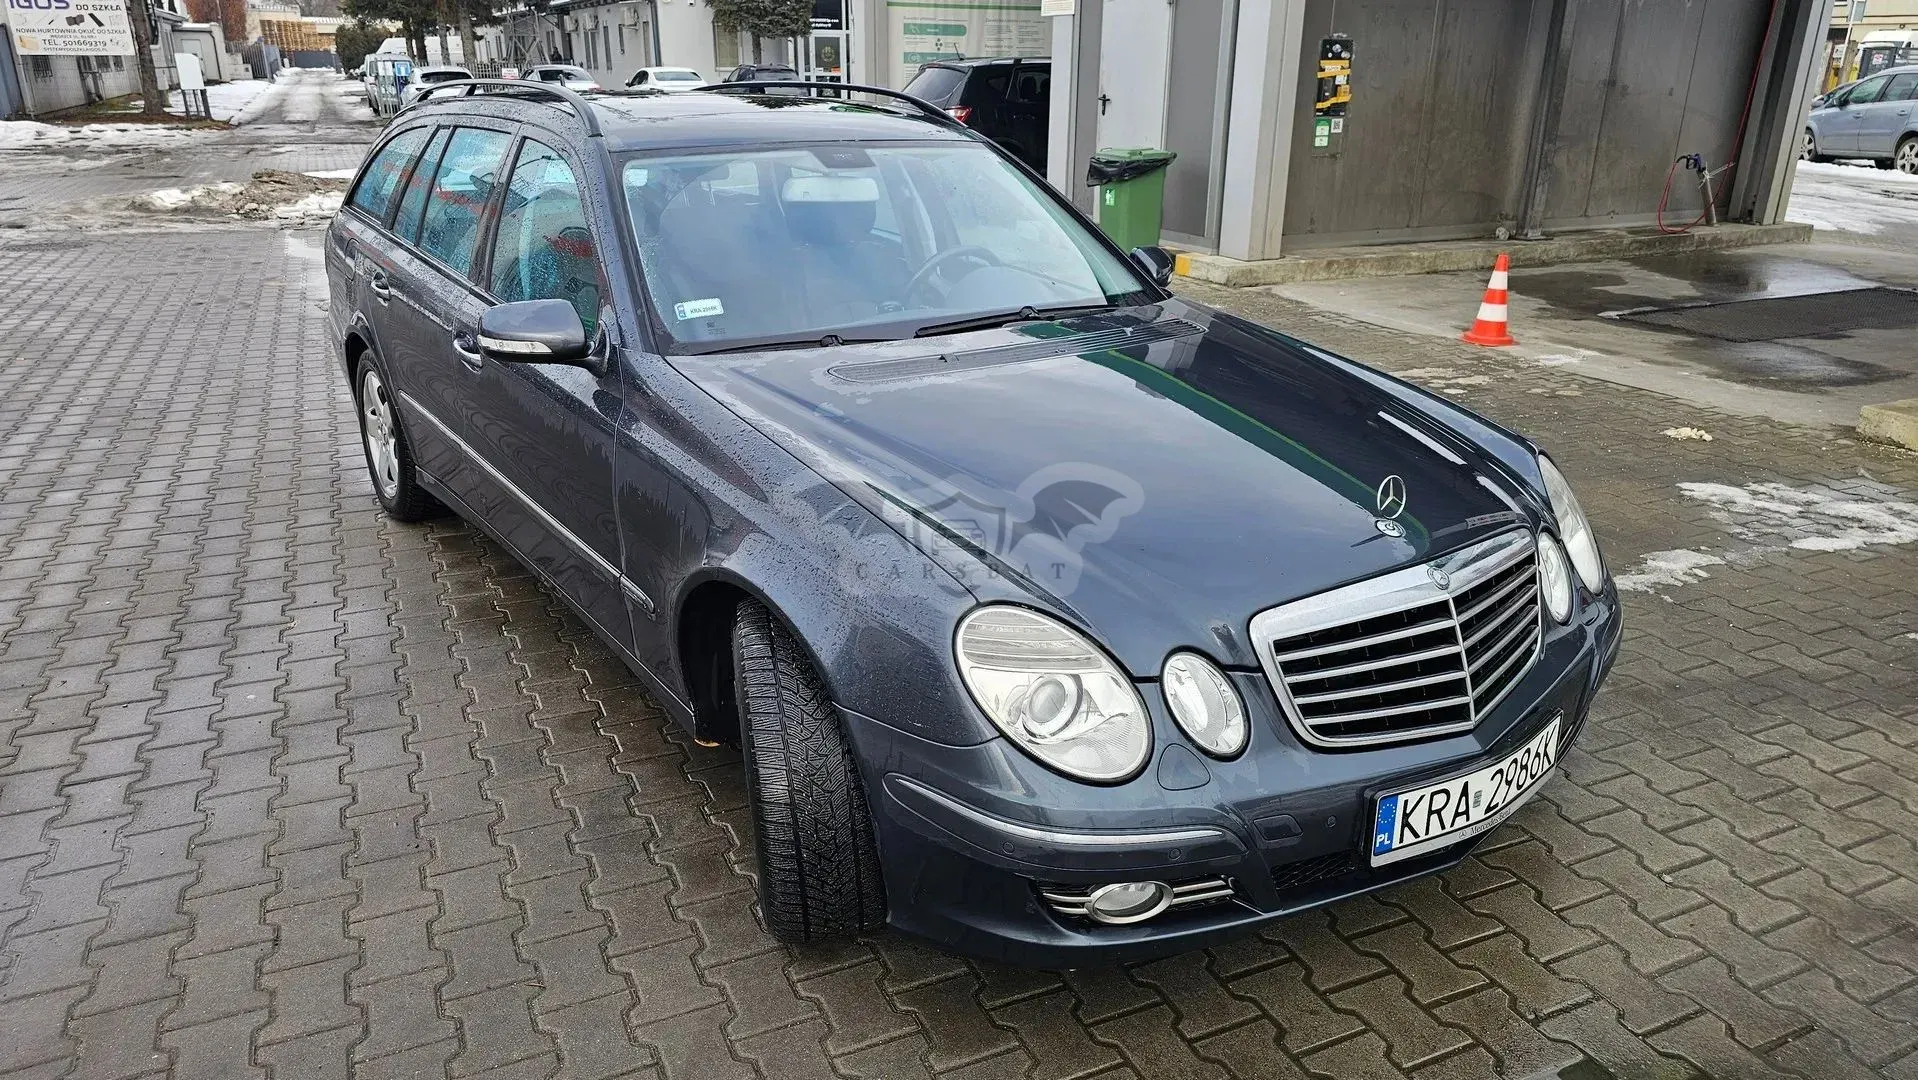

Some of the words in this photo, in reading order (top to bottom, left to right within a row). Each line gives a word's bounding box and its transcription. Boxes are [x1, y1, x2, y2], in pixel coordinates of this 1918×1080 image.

[63, 39, 107, 47] 501669319
[1398, 780, 1470, 844] KRA
[1484, 724, 1557, 815] 2986K
[1375, 833, 1391, 848] PL
